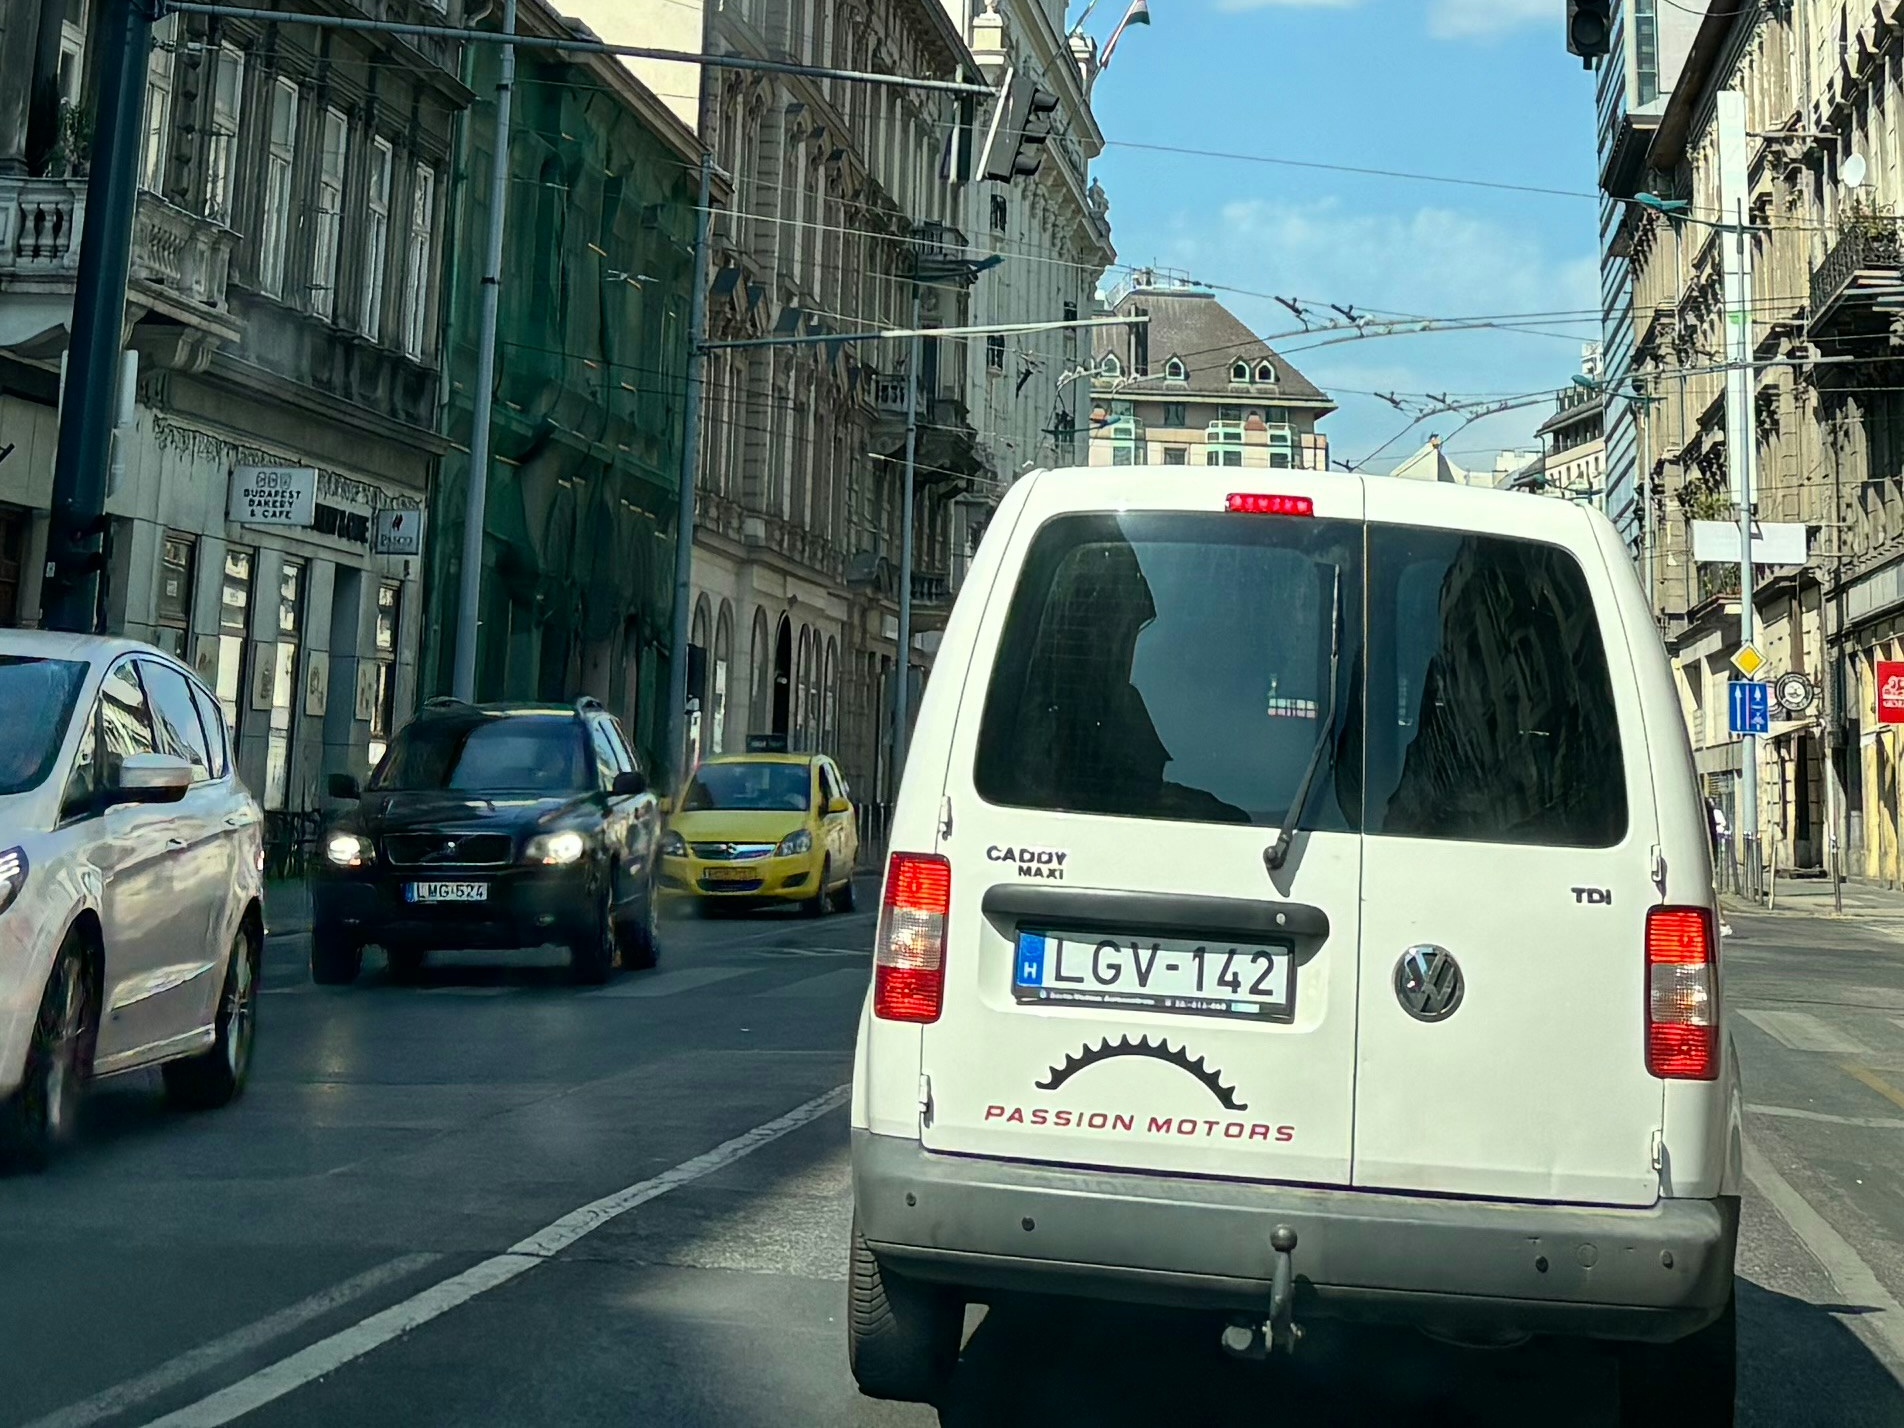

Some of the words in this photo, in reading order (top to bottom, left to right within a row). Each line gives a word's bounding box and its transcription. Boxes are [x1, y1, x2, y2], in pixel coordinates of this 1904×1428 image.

[986, 845, 1067, 866] CADDY
[1017, 865, 1065, 880] MAXI
[1571, 886, 1613, 906] TDI
[1023, 962, 1038, 979] H
[1054, 939, 1275, 997] LGV-142
[984, 1105, 1135, 1132] PASSION
[1147, 1116, 1295, 1142] MOTORS
